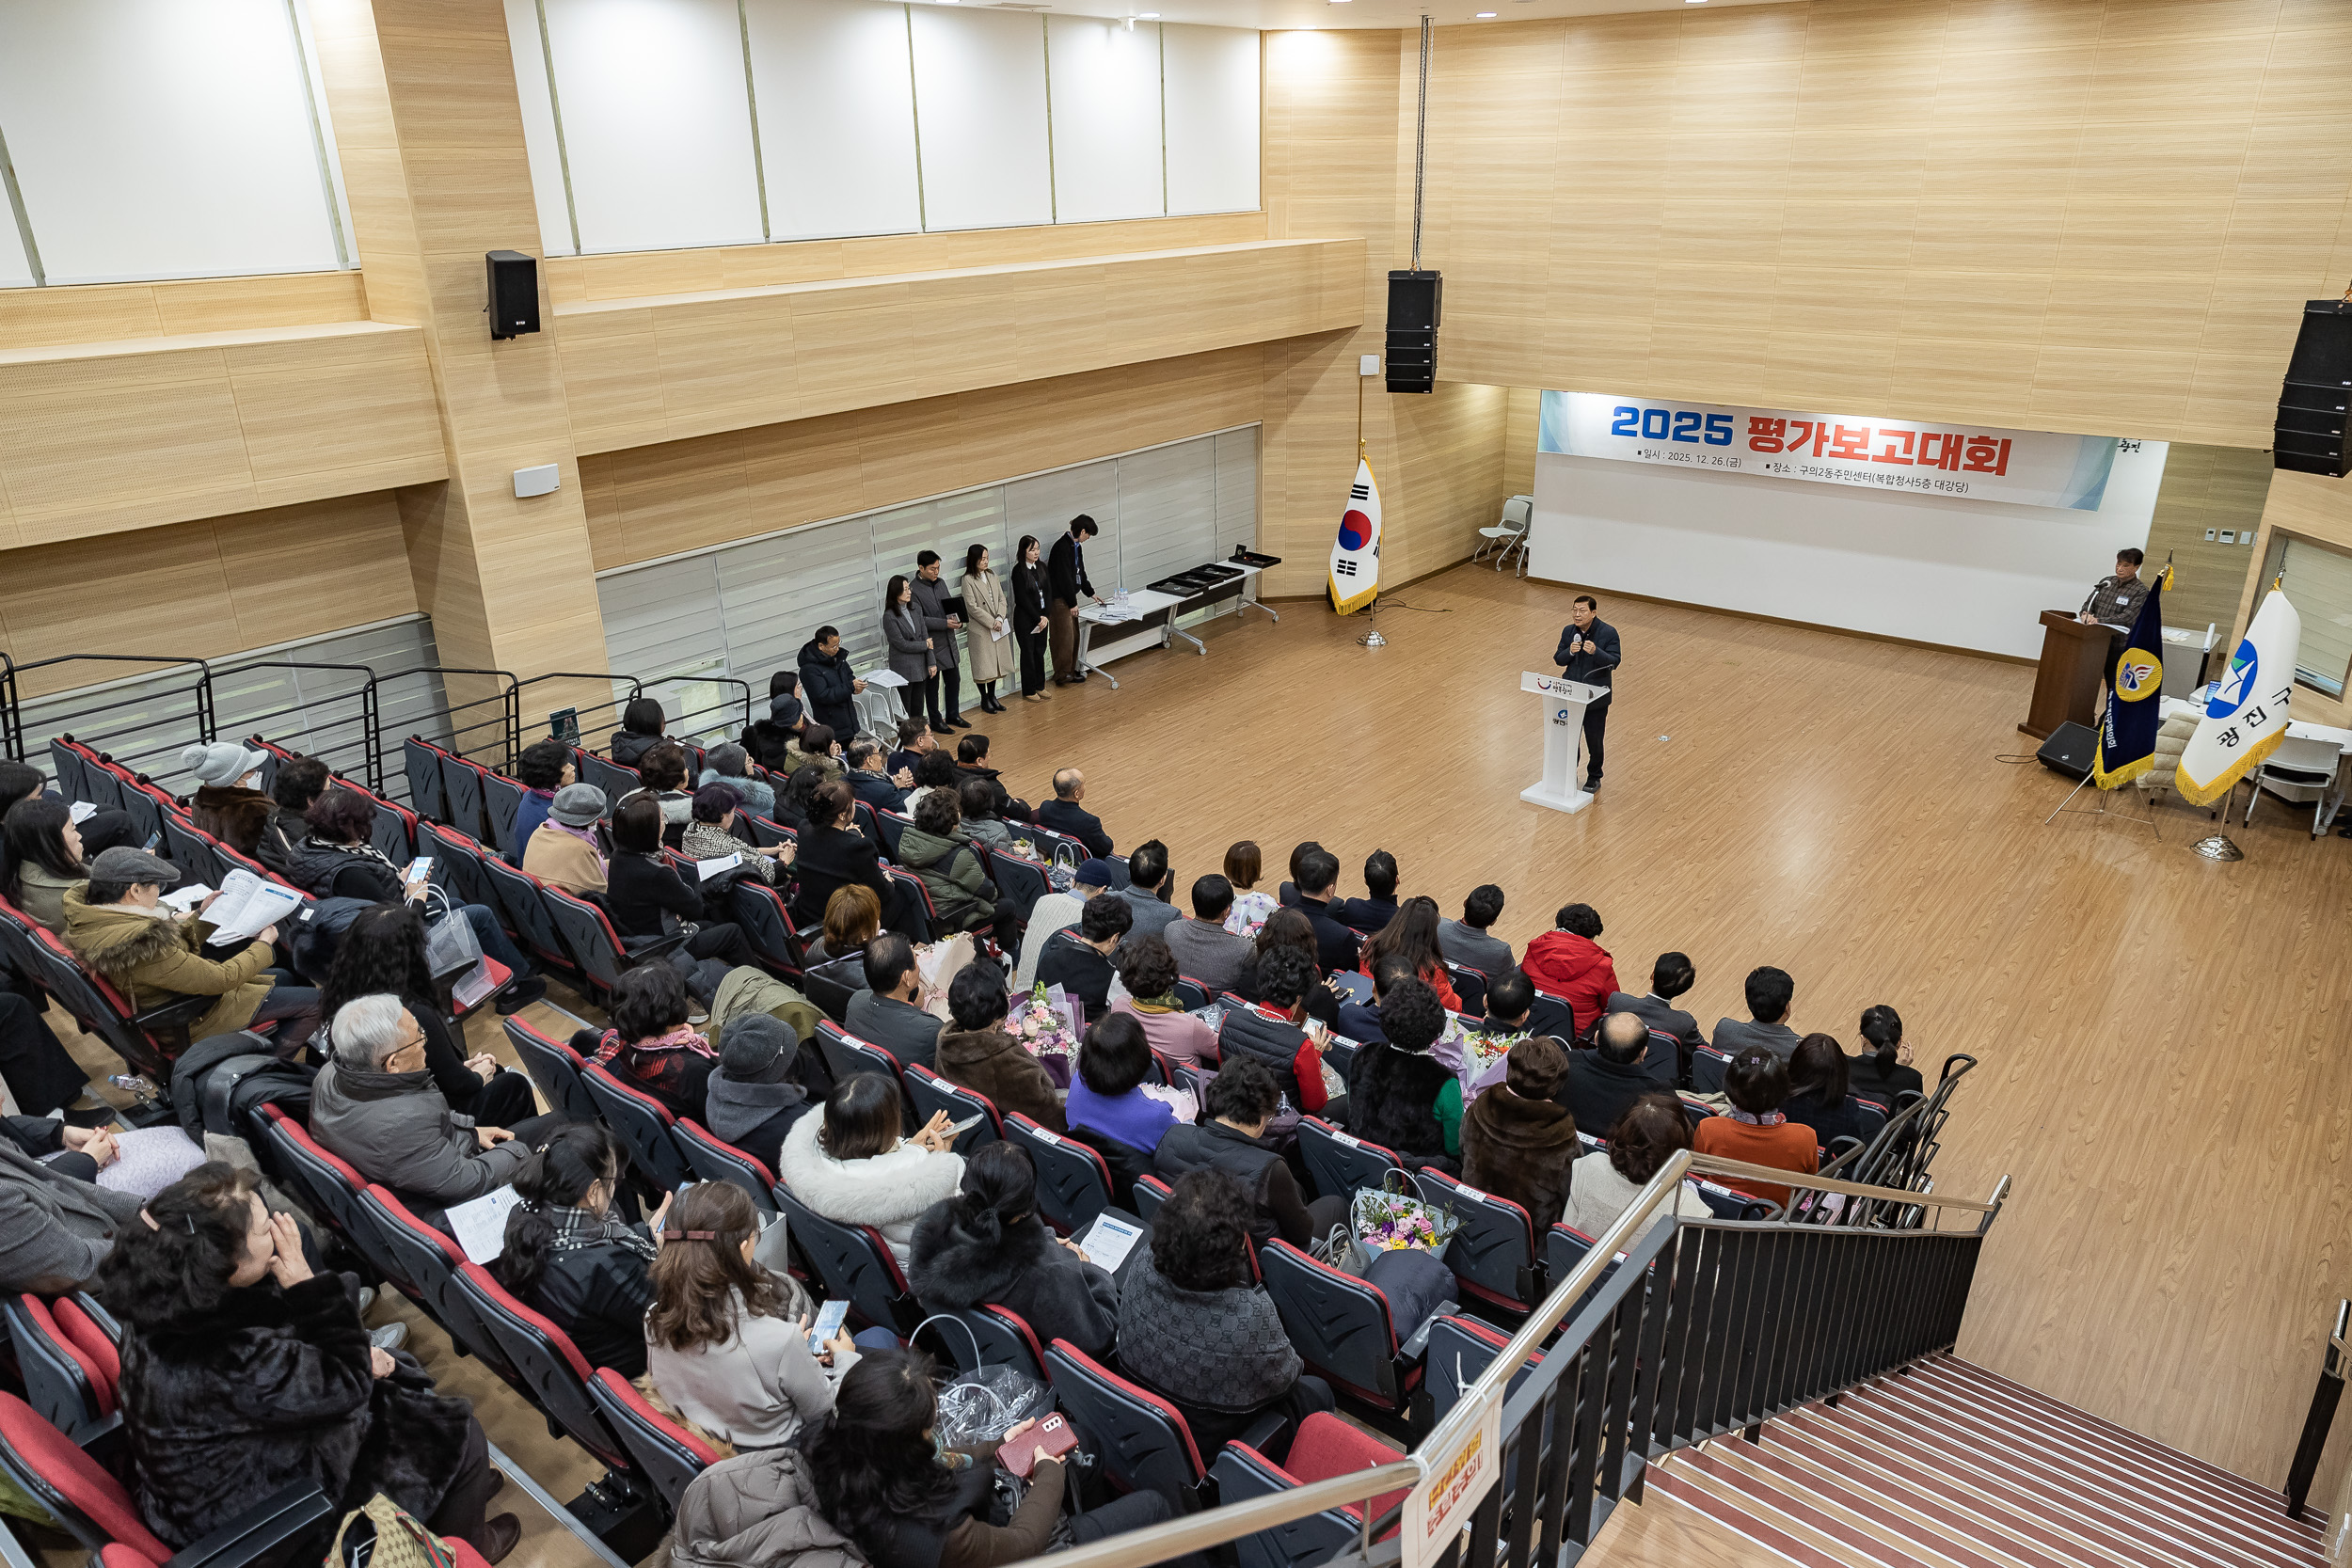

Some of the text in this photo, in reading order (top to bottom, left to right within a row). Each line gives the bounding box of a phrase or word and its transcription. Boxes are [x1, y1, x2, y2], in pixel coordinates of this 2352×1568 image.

[1612, 406, 2012, 477] 2025 평가보고대회
[1644, 449, 1661, 459] 일시
[1668, 451, 1692, 463] 2025.
[1696, 454, 1709, 465] 12.
[1711, 457, 1741, 468] 26.(금)
[1772, 463, 1791, 473] 장소
[1799, 466, 1931, 489] 구의2동주민센터(복합청사5층
[1934, 480, 1969, 494] 대강당)
